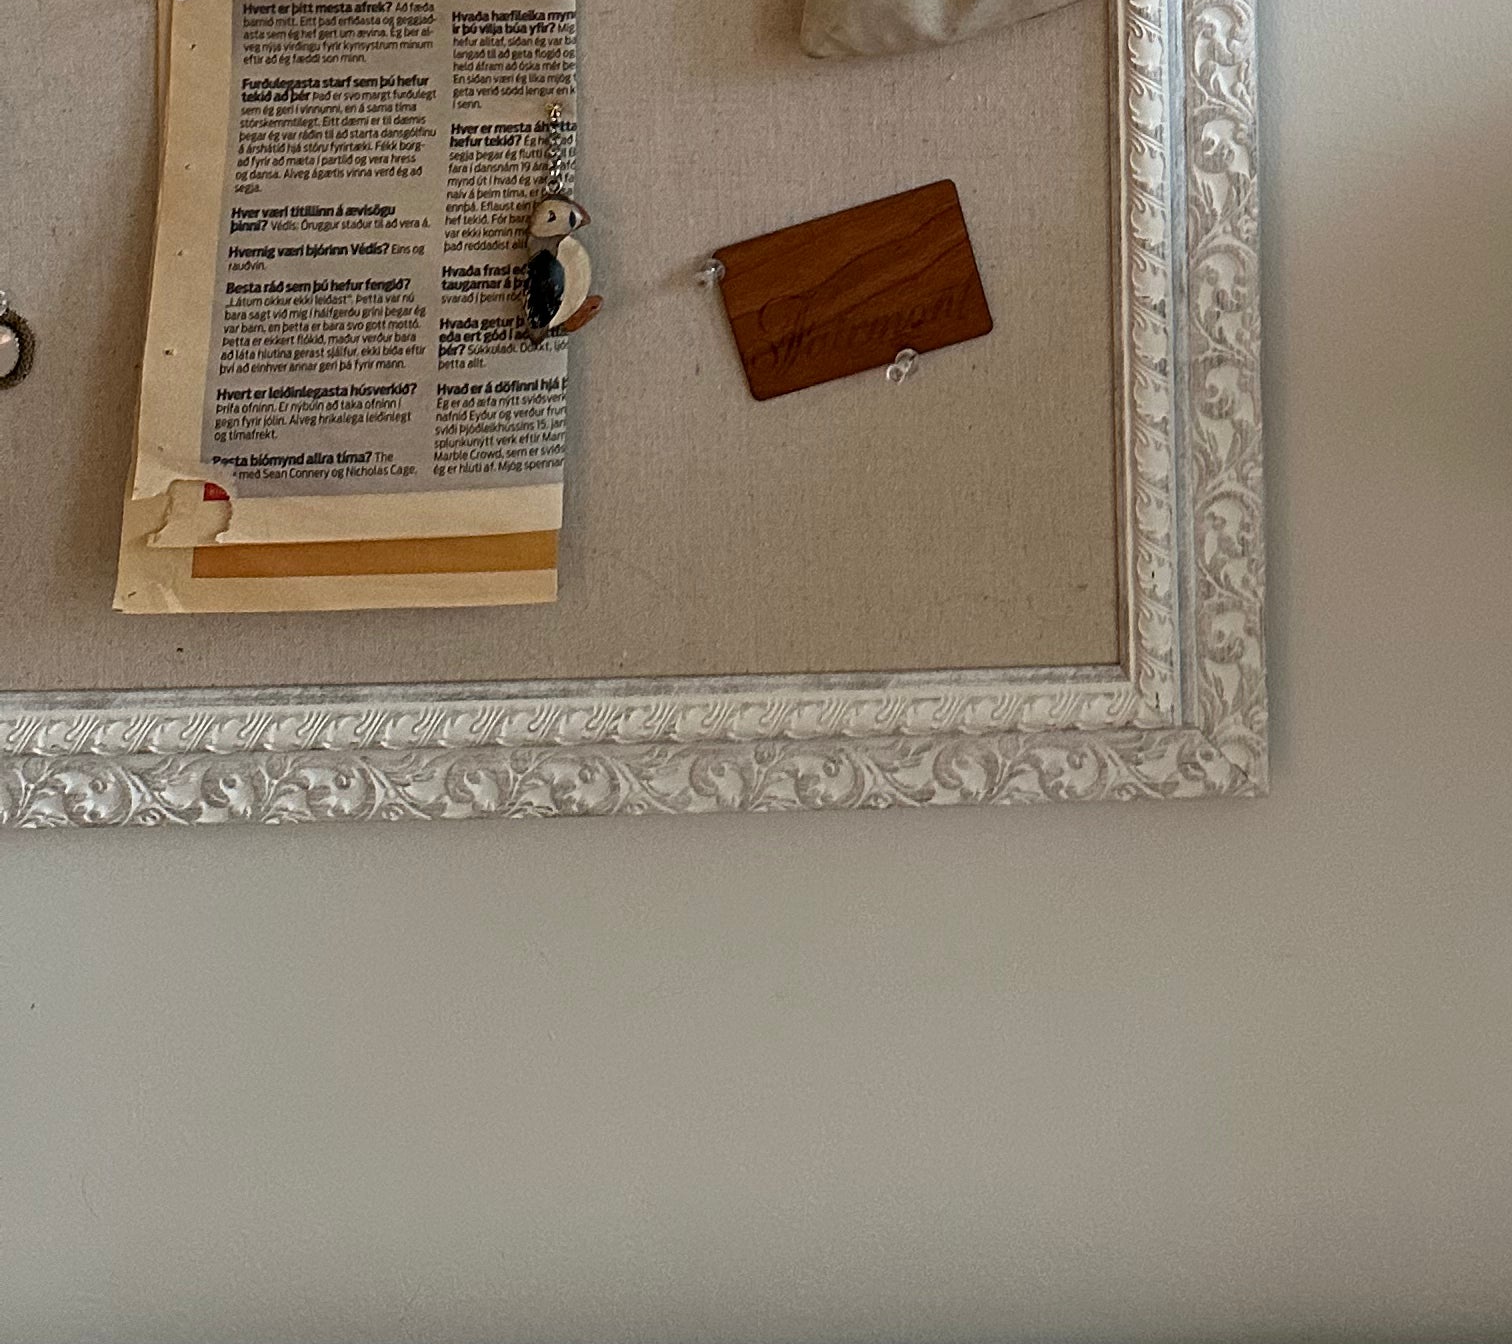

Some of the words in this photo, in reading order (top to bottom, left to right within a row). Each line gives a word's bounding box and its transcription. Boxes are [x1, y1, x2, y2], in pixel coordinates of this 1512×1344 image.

[243, 3, 276, 15] Hvert
[278, 4, 289, 14] er
[316, 2, 350, 13] mesta
[354, 0, 392, 13] afrek?
[322, 76, 351, 87] starf
[353, 78, 377, 87] sem
[397, 74, 429, 86] hefur
[451, 124, 478, 134] Hver
[480, 124, 492, 134] er
[494, 123, 532, 133] mesta
[450, 137, 483, 147] hefur
[231, 207, 259, 219] Hver
[226, 282, 261, 294] Besta
[286, 282, 311, 292] sem
[331, 279, 364, 290] hefur
[216, 389, 251, 401] Hvert
[254, 389, 267, 399] er
[437, 383, 469, 395] Hvað
[470, 384, 483, 394] er
[306, 453, 333, 465] allra
[375, 452, 394, 462] The
